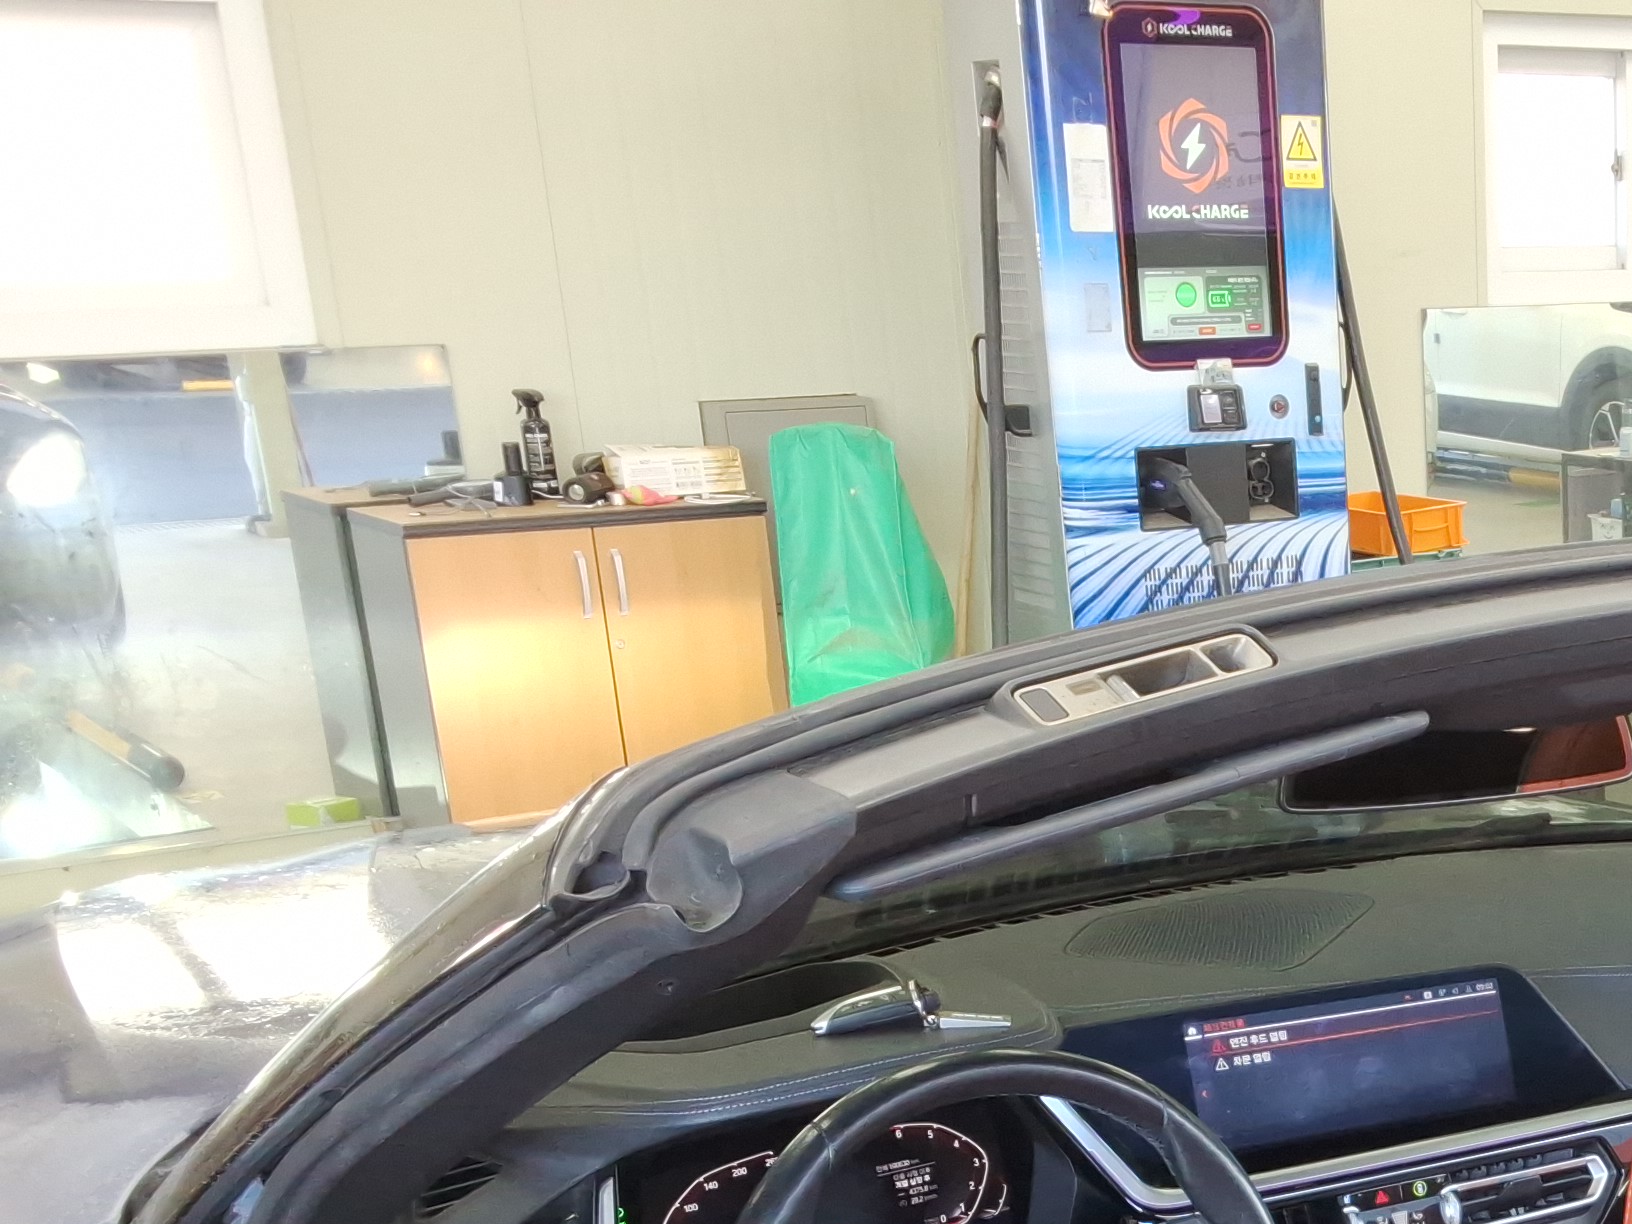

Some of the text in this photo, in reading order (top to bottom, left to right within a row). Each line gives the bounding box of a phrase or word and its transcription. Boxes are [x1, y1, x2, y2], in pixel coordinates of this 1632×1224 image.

[896, 1129, 903, 1139] 6
[927, 1129, 934, 1139] 5
[953, 1139, 960, 1148] 4
[972, 1157, 980, 1167] 3
[732, 1166, 748, 1177] 200
[703, 1180, 719, 1191] 140
[968, 1181, 976, 1191] 2
[683, 1202, 699, 1213] 100
[940, 1214, 947, 1223] 0
